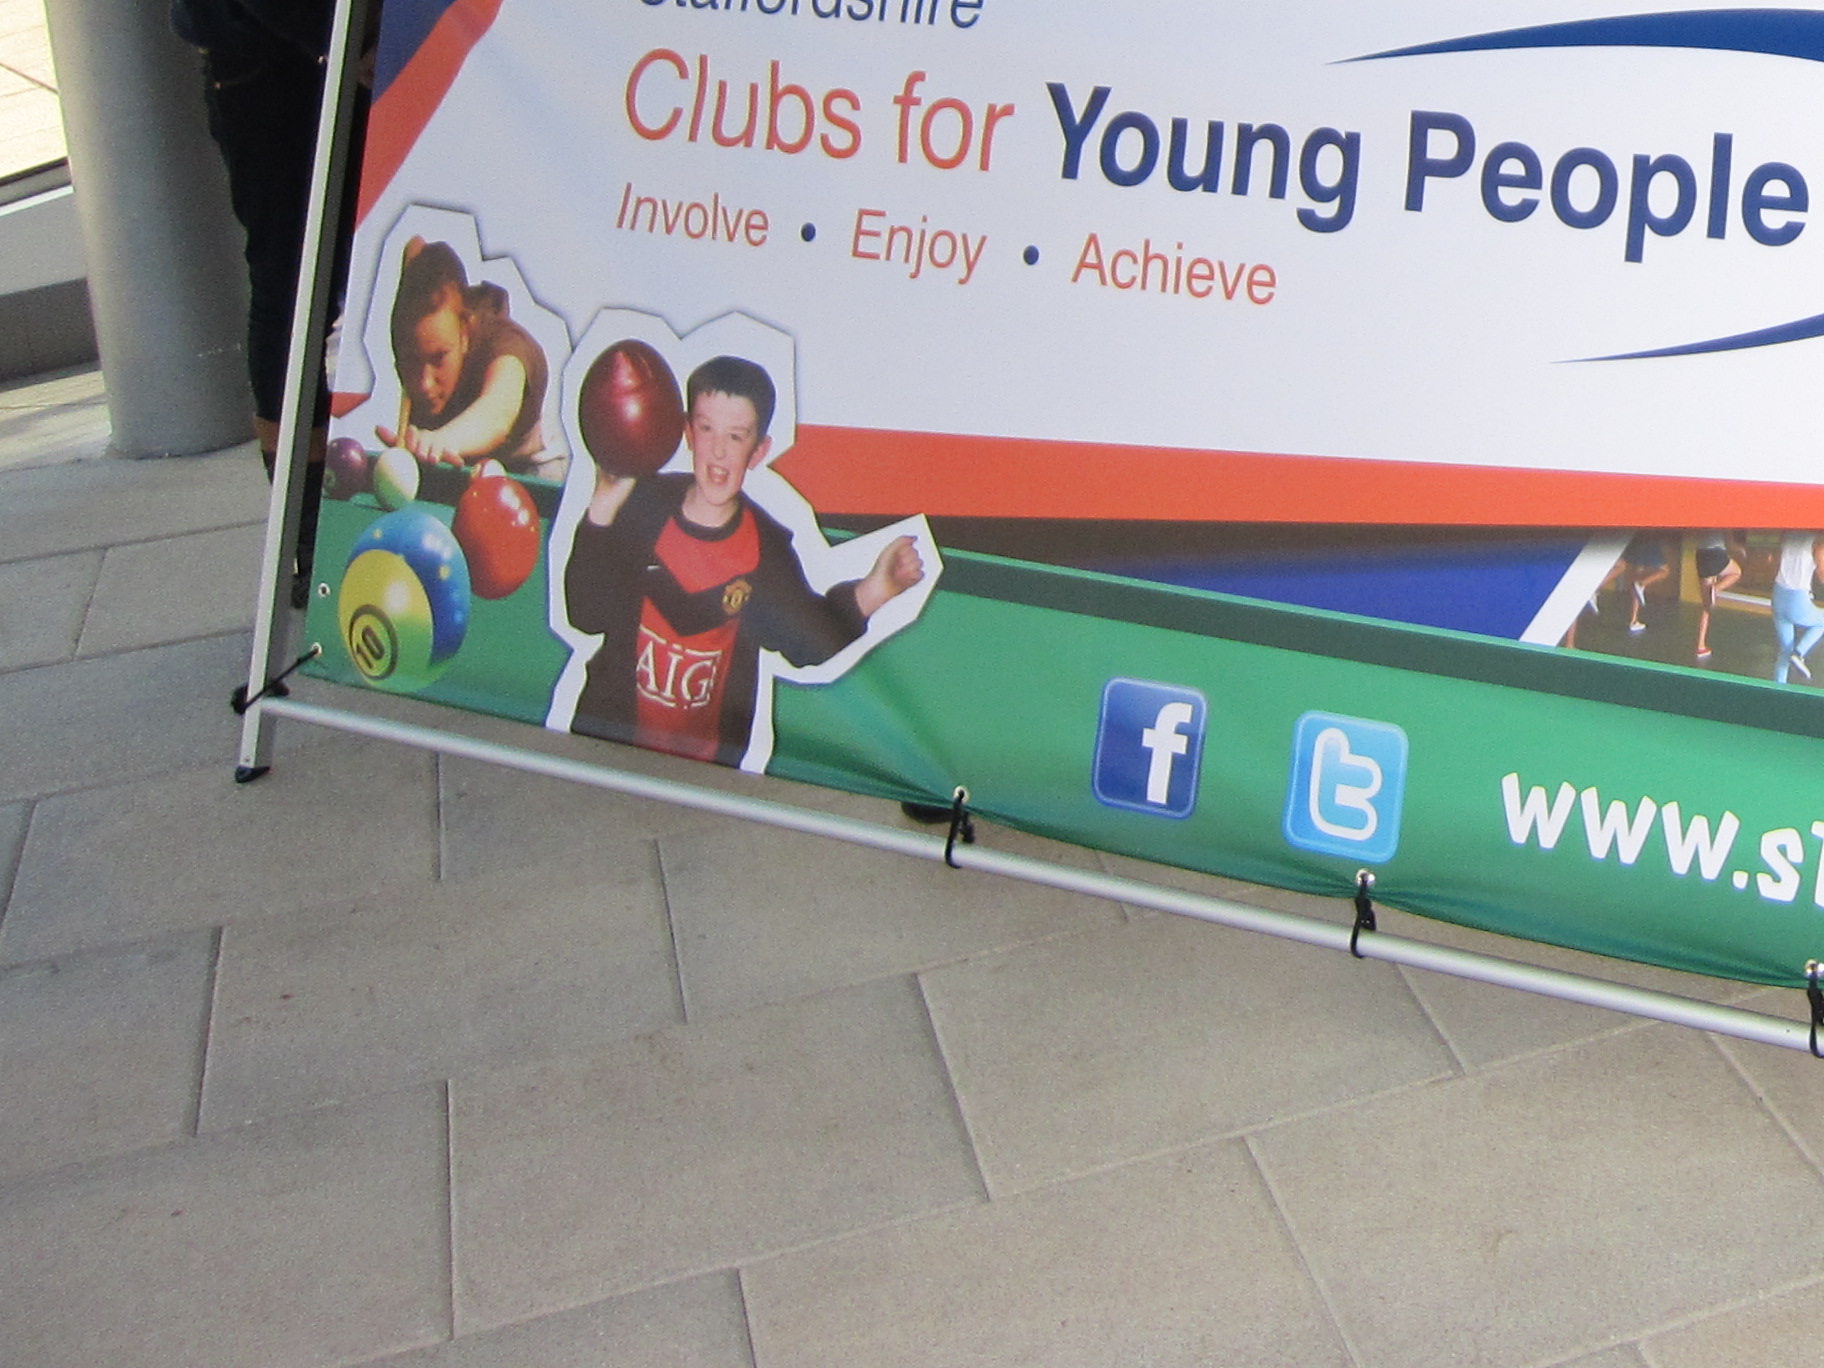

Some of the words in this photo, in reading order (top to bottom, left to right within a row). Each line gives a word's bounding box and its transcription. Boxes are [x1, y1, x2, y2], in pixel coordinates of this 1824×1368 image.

[625, 48, 861, 159] Clubs
[892, 70, 1015, 172] for
[1045, 81, 1362, 234] Young
[1403, 109, 1810, 264] People
[616, 182, 769, 247] Involve
[851, 208, 987, 285] Enjoy
[1071, 233, 1277, 306] Achieve
[356, 625, 385, 669] 10
[636, 640, 715, 706] AIG
